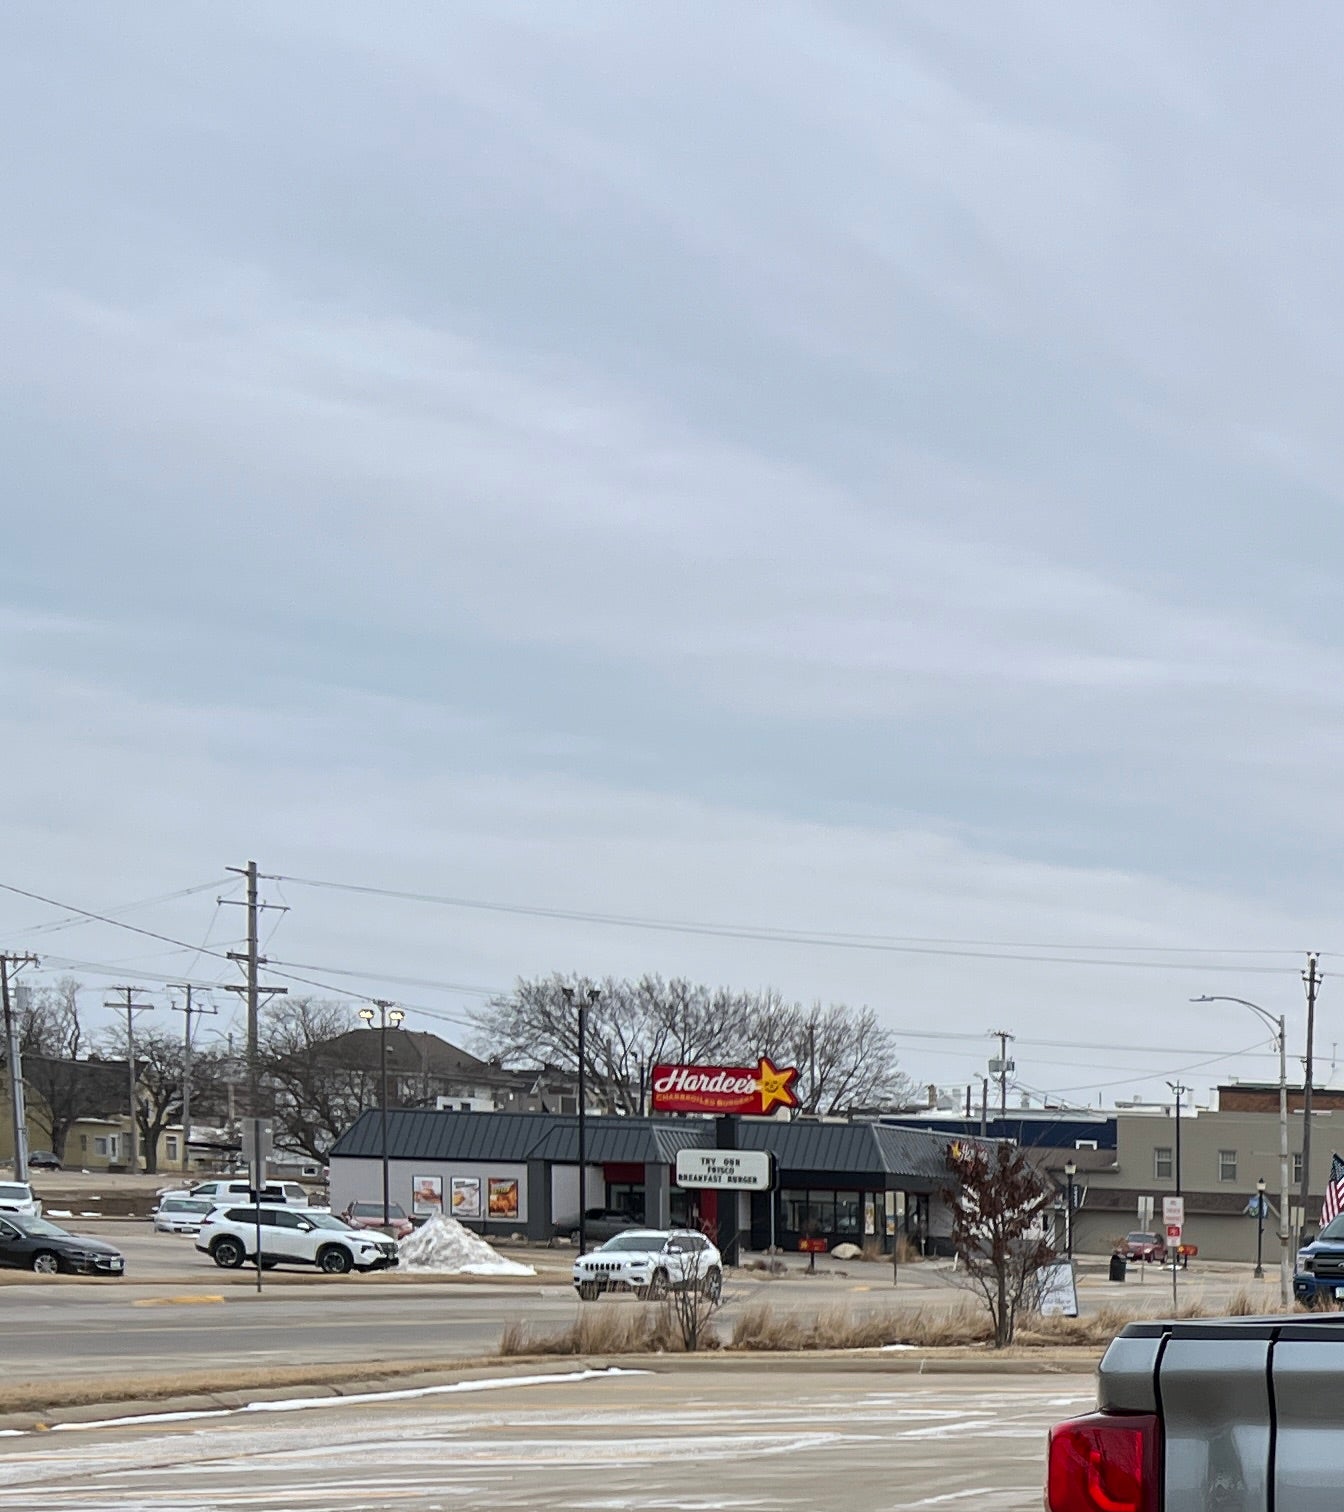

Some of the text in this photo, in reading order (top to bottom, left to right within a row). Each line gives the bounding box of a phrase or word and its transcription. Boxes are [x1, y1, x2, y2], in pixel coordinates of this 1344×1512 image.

[654, 1069, 757, 1094] Hardee's
[701, 1157, 741, 1167] TRY OUR
[678, 1174, 758, 1185] BREAKFAST BURGER
